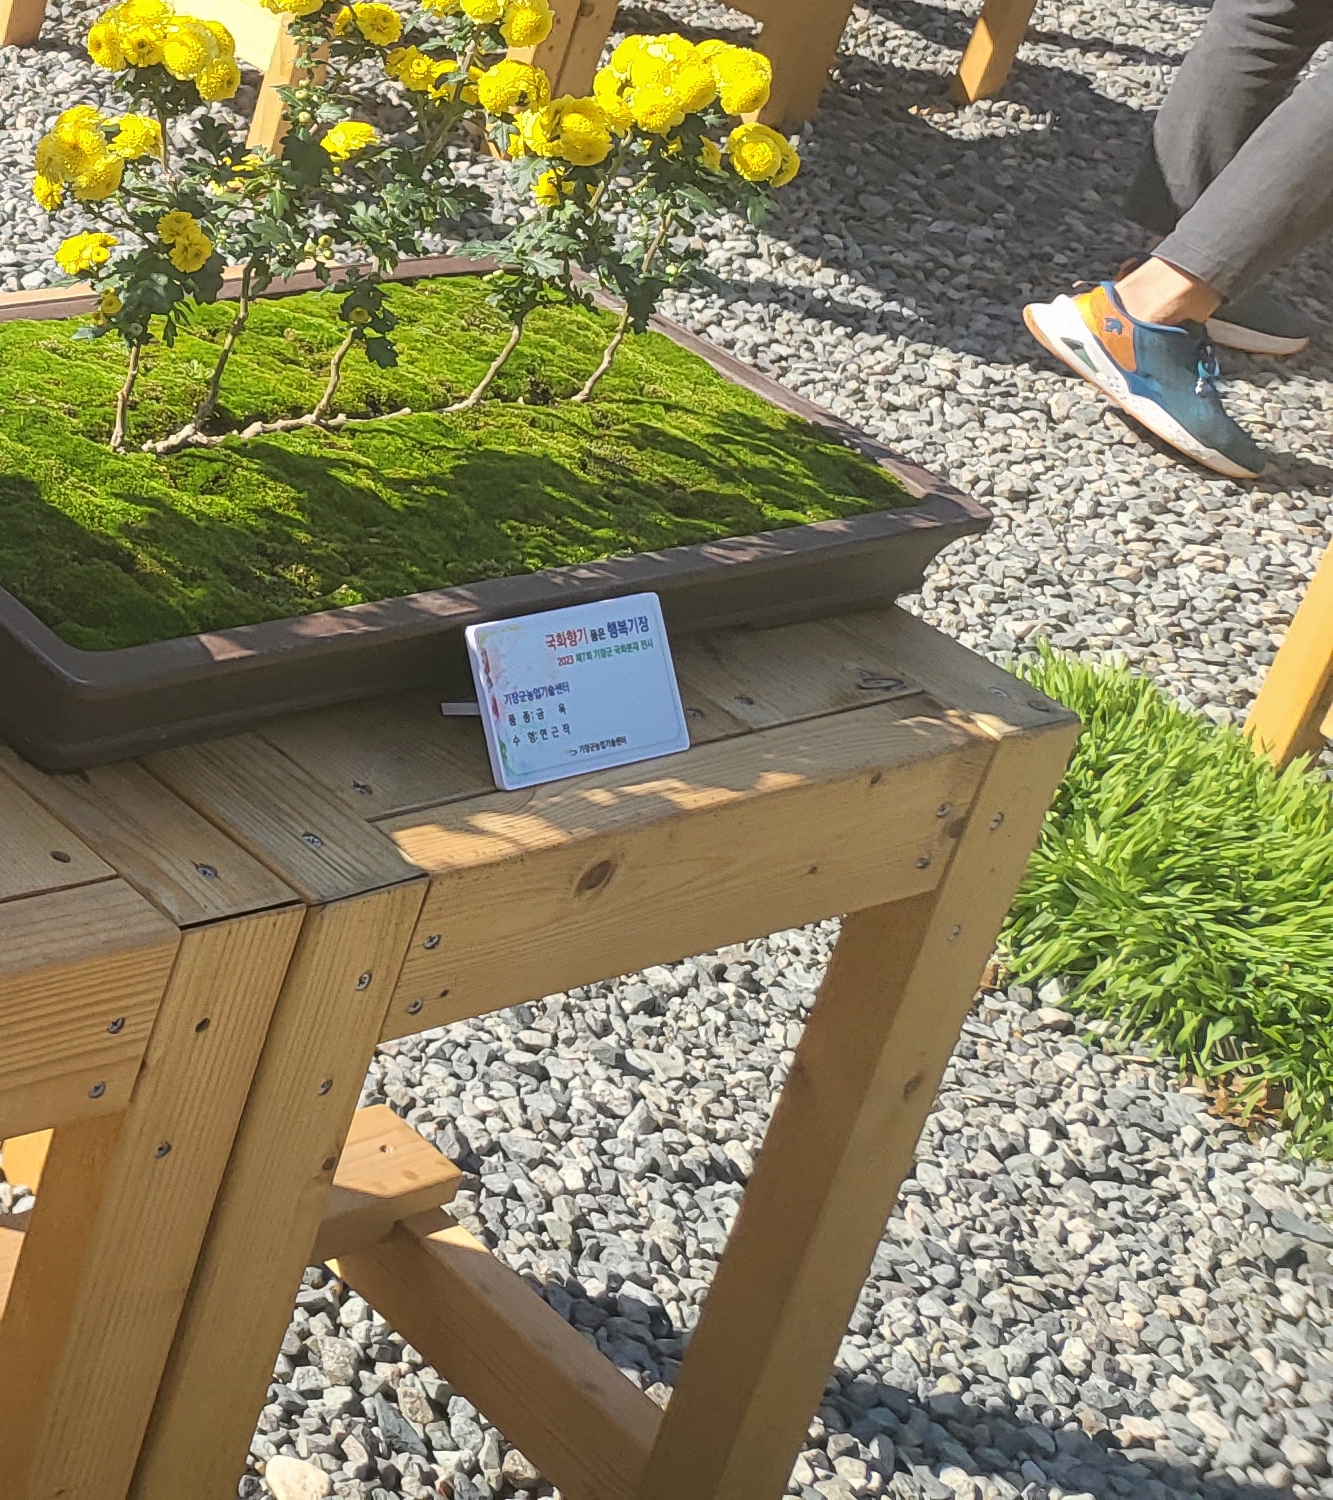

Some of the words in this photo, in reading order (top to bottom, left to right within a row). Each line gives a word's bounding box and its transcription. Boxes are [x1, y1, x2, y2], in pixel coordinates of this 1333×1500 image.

[545, 627, 589, 651] 국화향기
[607, 615, 650, 639] 행복기장
[557, 655, 574, 667] 2023
